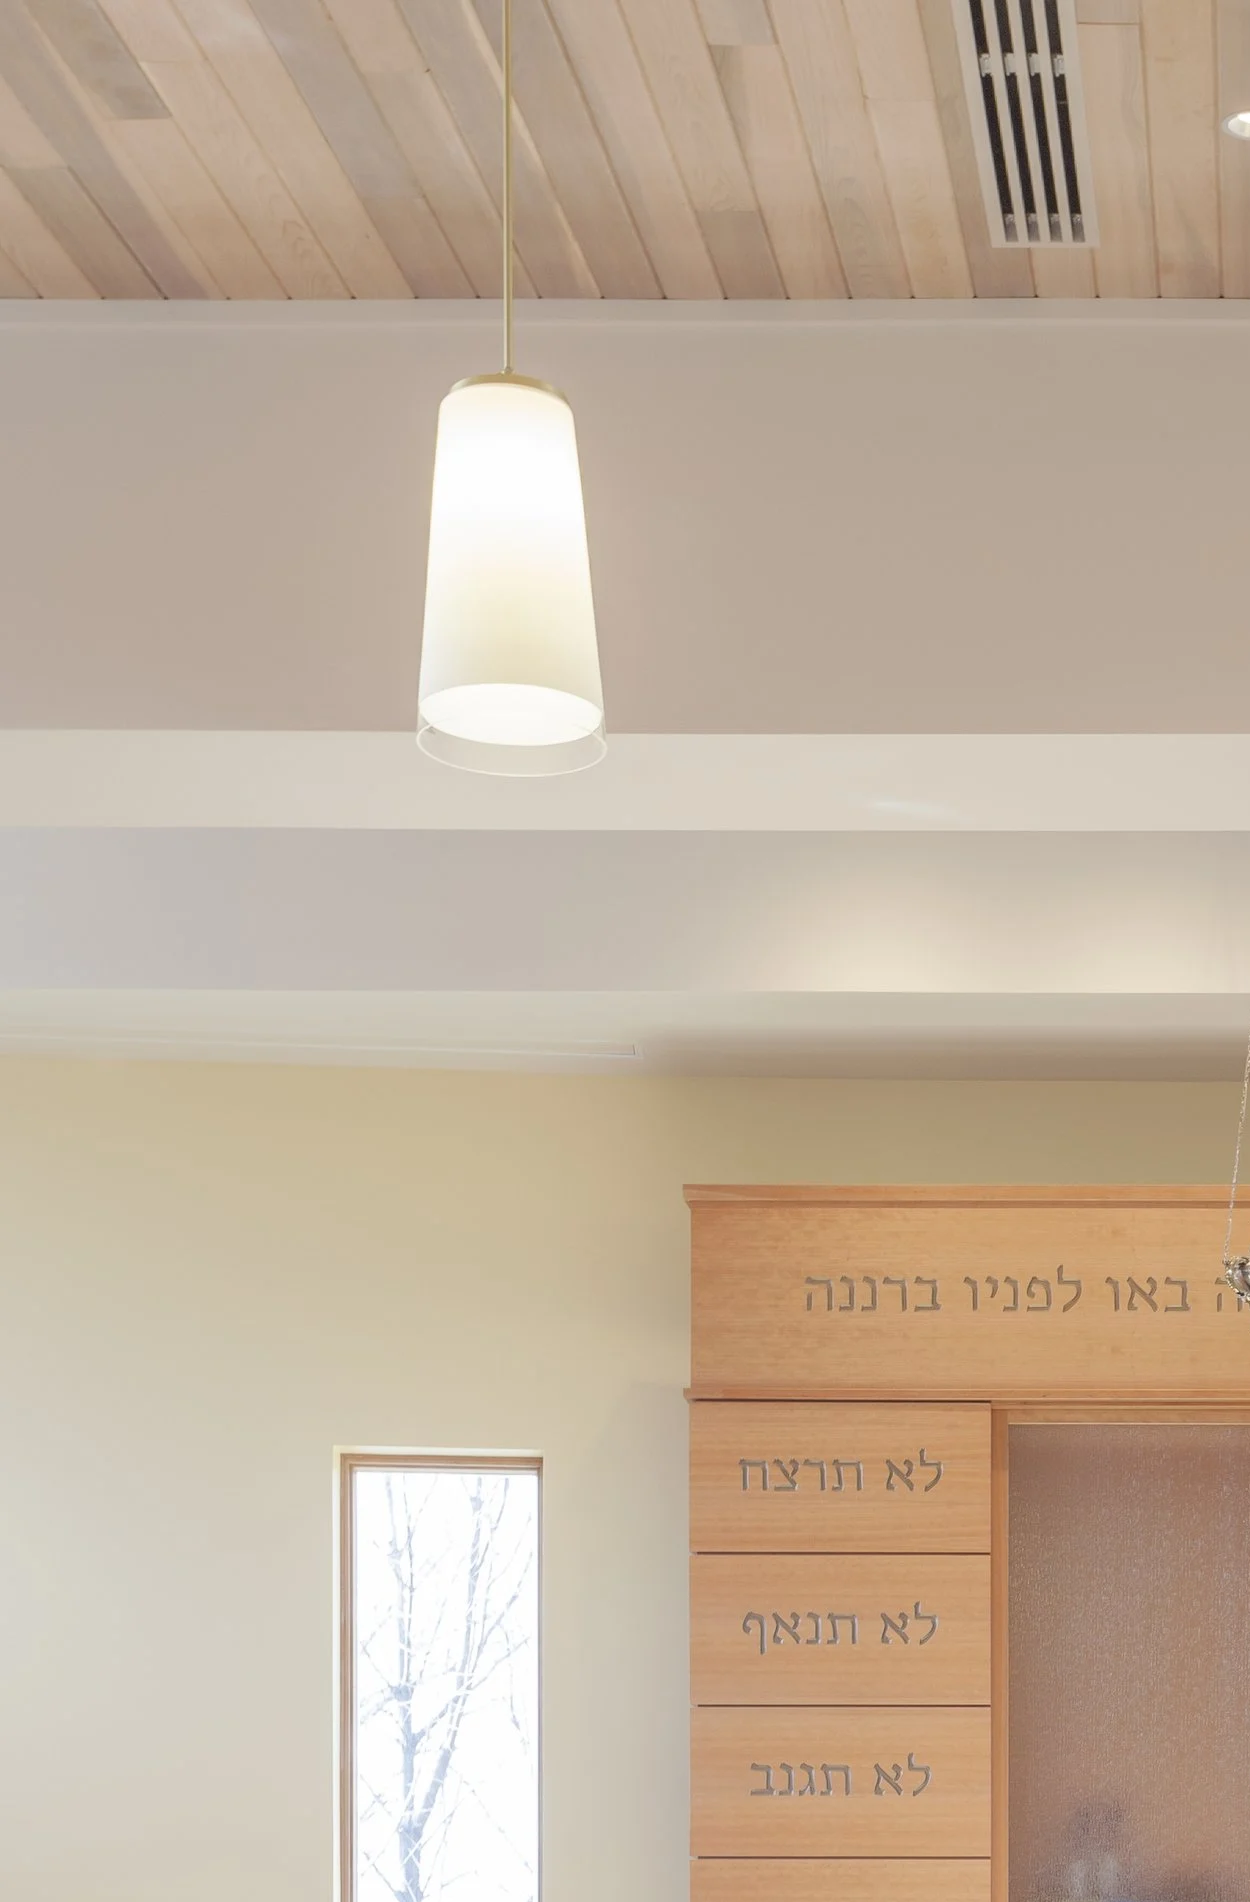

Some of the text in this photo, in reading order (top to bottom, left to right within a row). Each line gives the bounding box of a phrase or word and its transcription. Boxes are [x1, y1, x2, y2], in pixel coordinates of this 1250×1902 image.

[805, 1275, 943, 1313] ברננה
[964, 1266, 1083, 1313] לפניו
[1107, 1276, 1192, 1313] באו
[739, 1448, 946, 1495] לא תרצח
[741, 1601, 941, 1656] לא תנאף
[749, 1752, 933, 1799] לא תגנב
